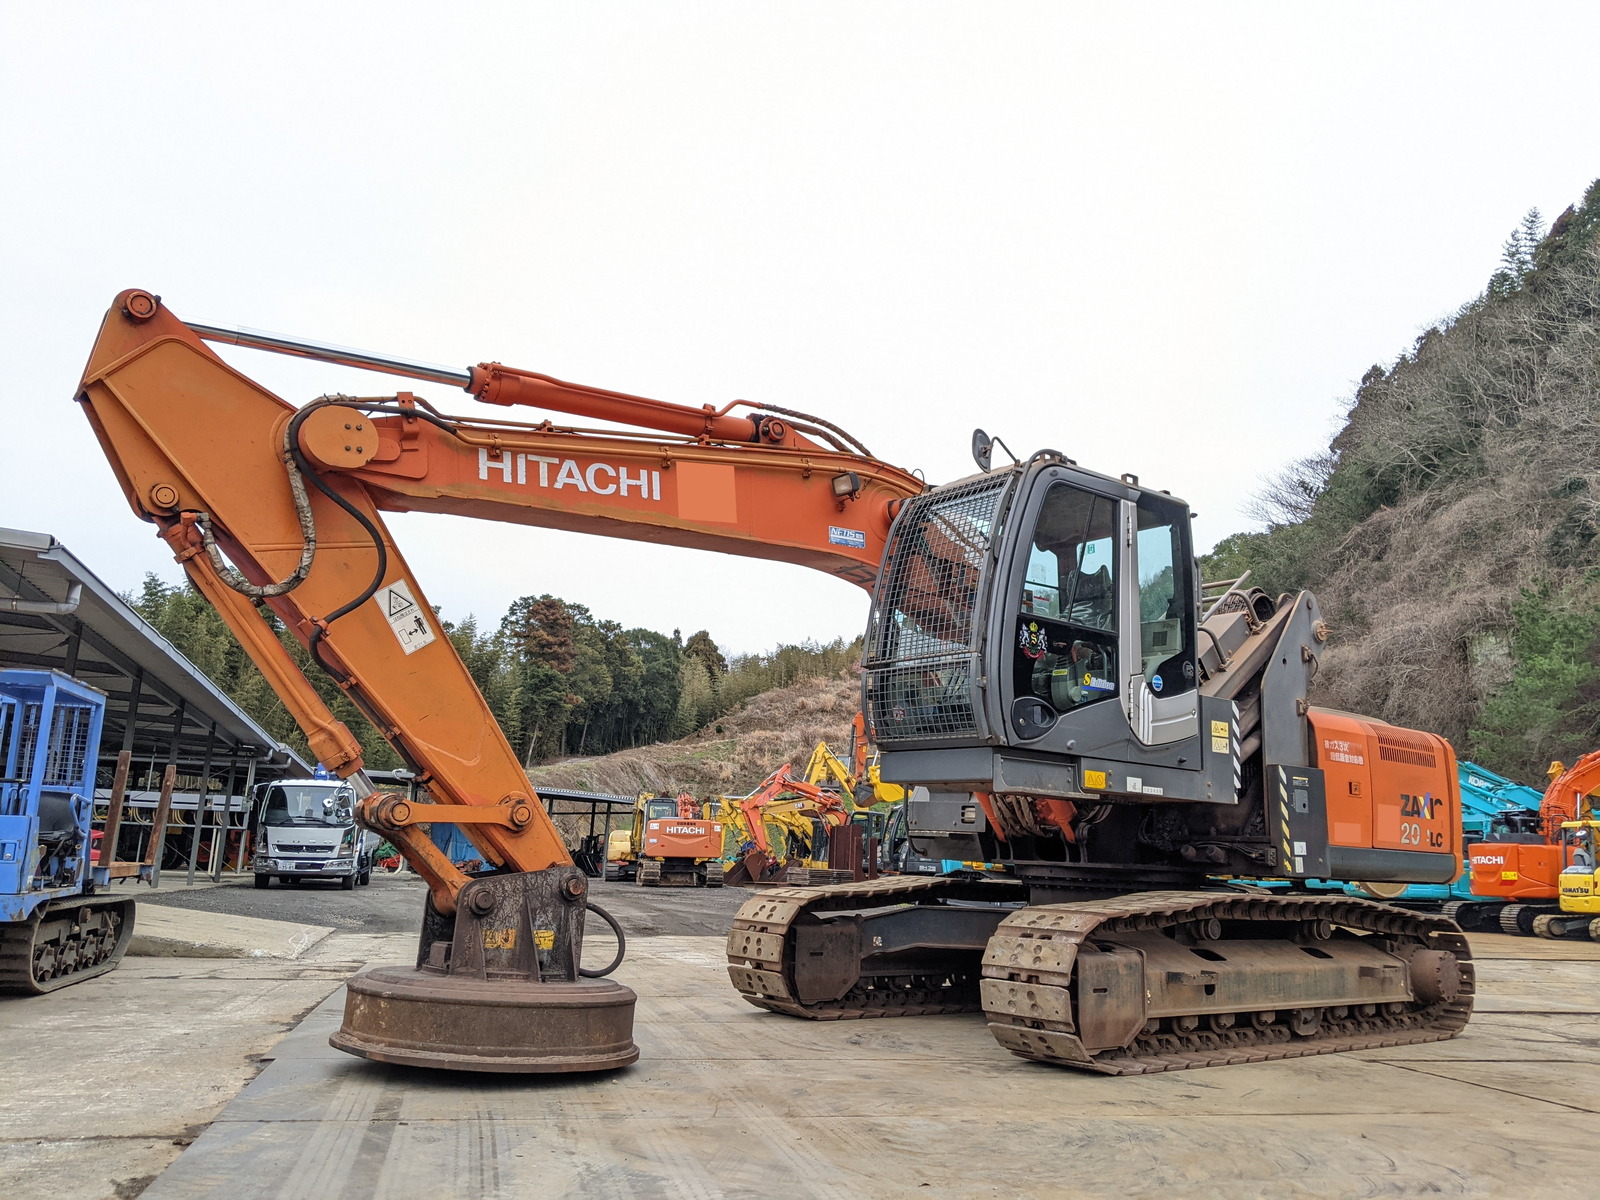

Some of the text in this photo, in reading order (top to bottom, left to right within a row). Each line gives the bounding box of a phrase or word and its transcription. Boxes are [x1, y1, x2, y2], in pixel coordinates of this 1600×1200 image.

[478, 448, 661, 501] HITACHI
[1091, 676, 1115, 691] Edition
[666, 826, 705, 834] HITACHI
